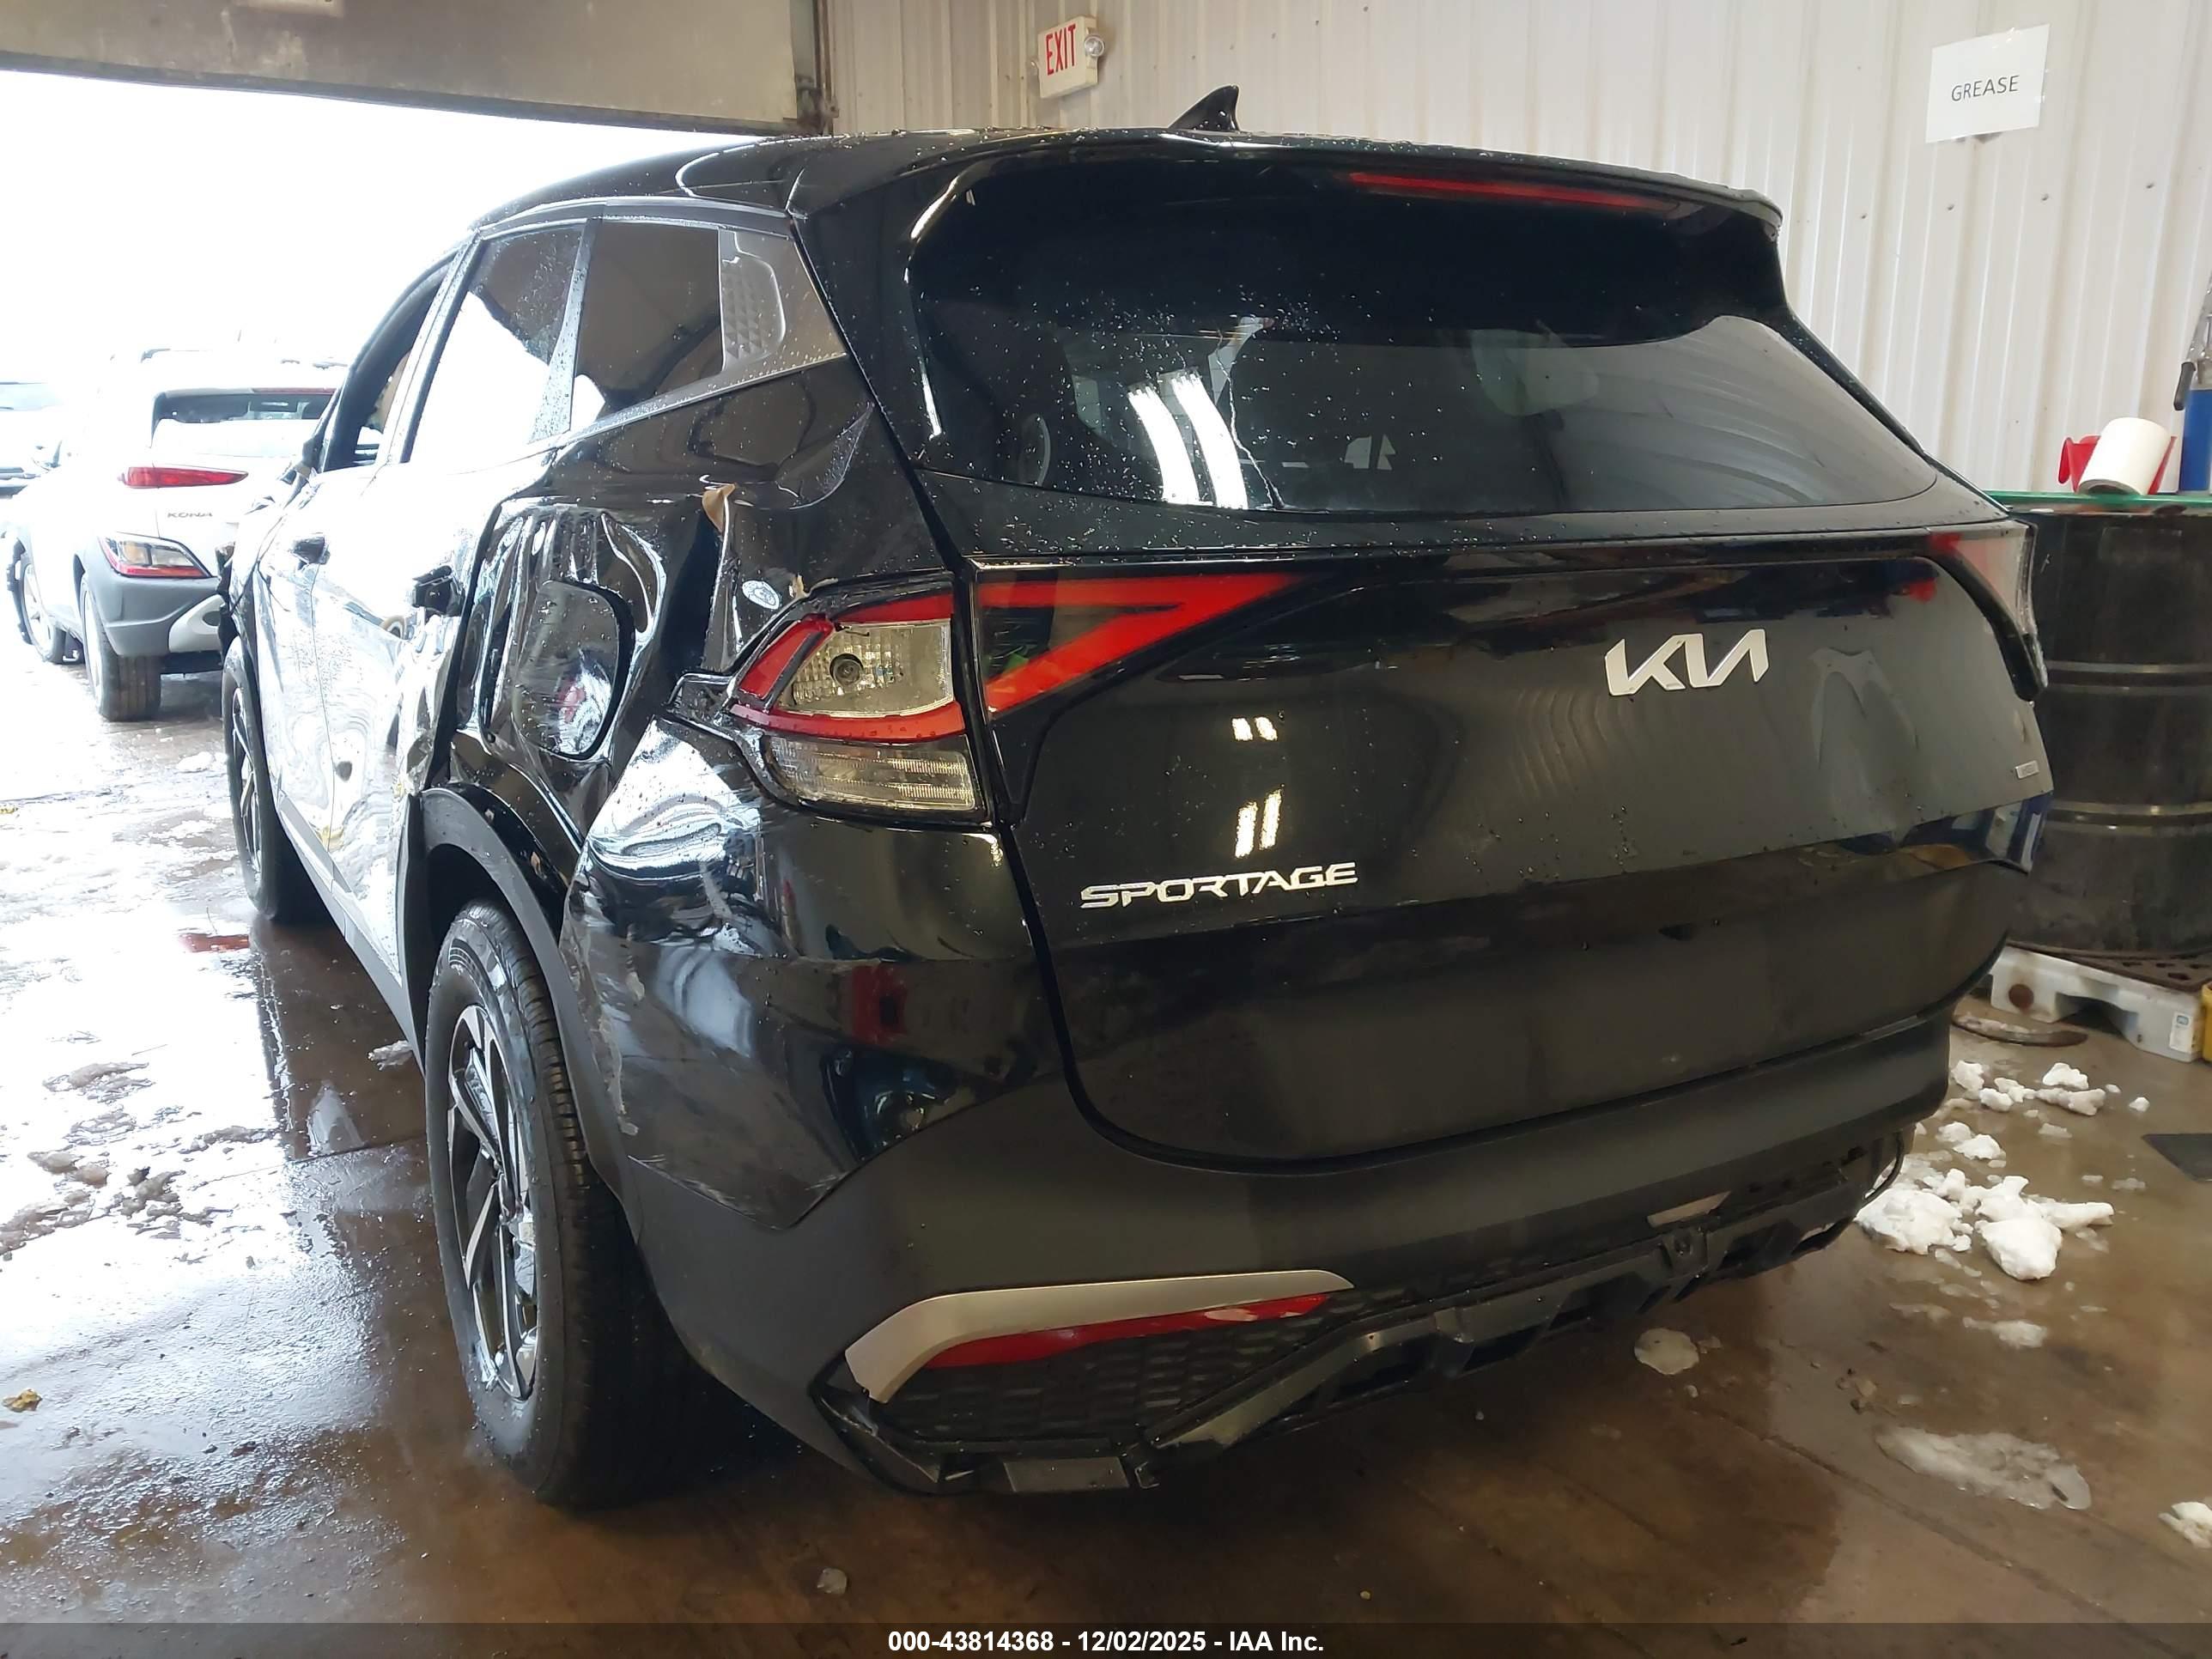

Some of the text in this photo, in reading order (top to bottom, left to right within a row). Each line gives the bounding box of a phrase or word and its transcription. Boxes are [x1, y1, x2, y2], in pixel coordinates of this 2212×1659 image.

[1045, 23, 1076, 76] EXIT
[1951, 75, 2020, 101] GREASE
[1605, 629, 1769, 696] KIA
[1079, 861, 1358, 908] SPORTAGE
